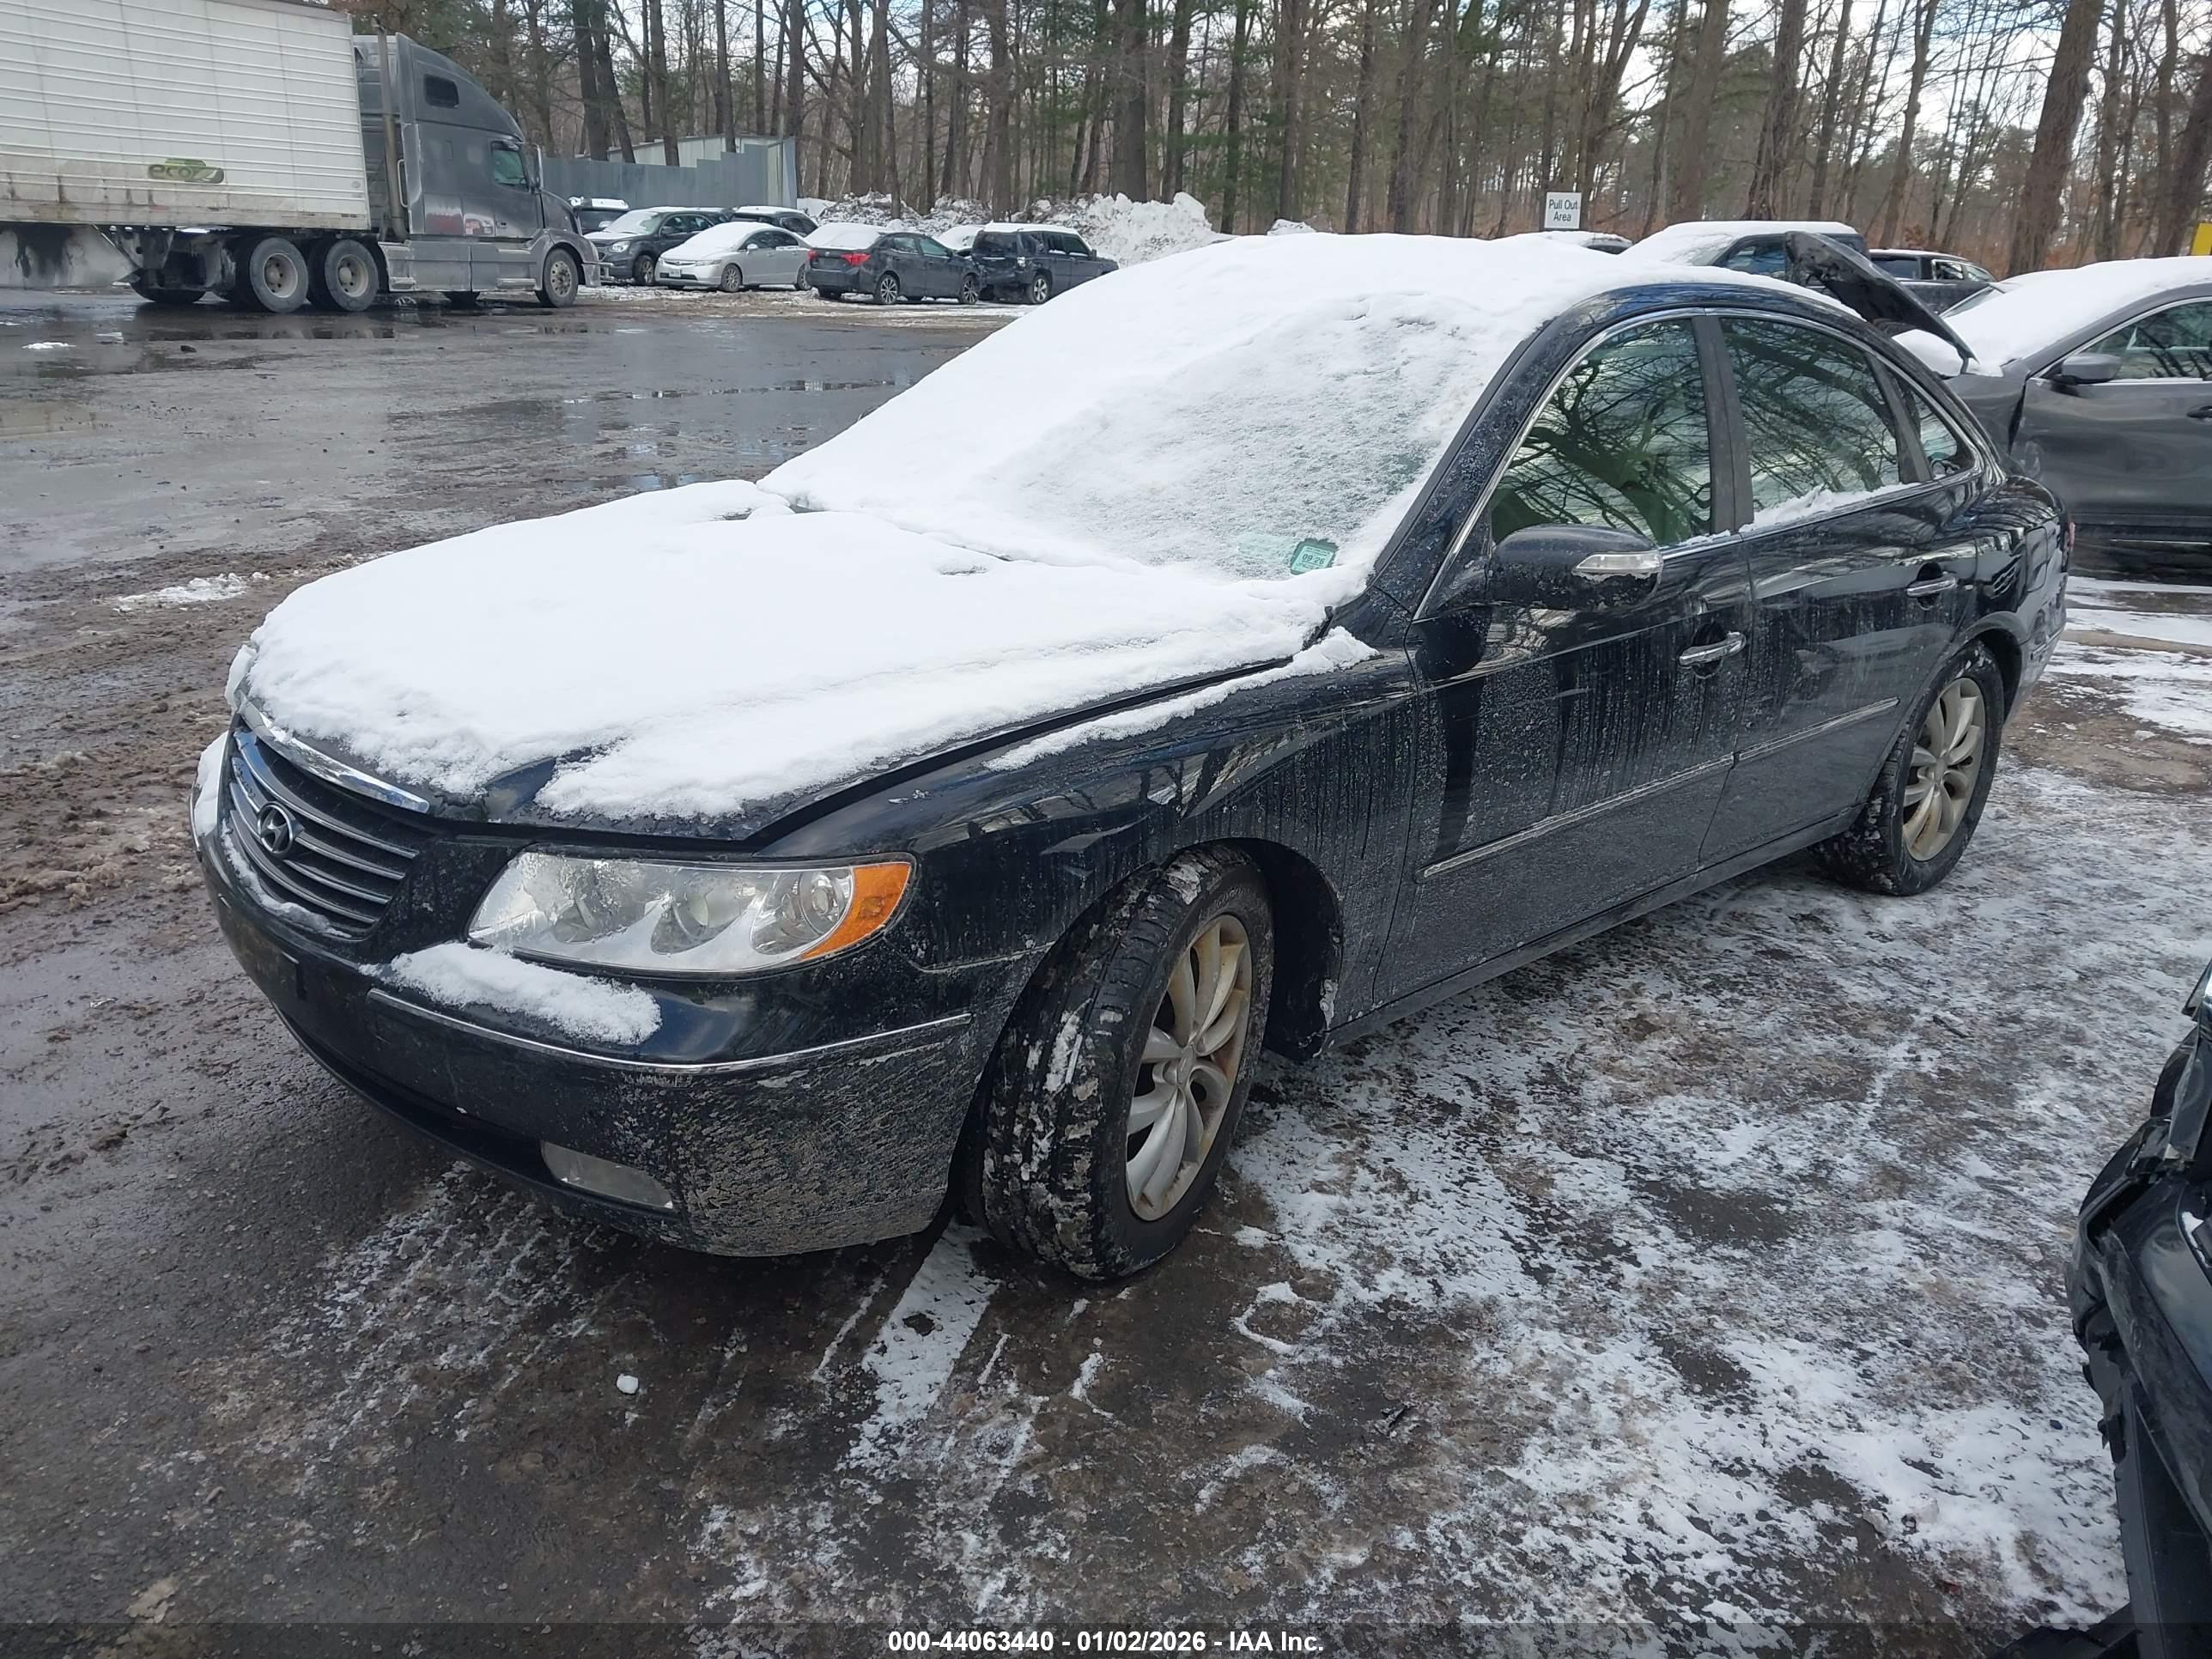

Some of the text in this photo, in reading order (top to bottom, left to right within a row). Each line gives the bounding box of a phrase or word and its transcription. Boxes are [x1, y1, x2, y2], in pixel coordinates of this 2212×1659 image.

[1548, 199, 1577, 210] Pull Out
[1553, 211, 1571, 222] Area
